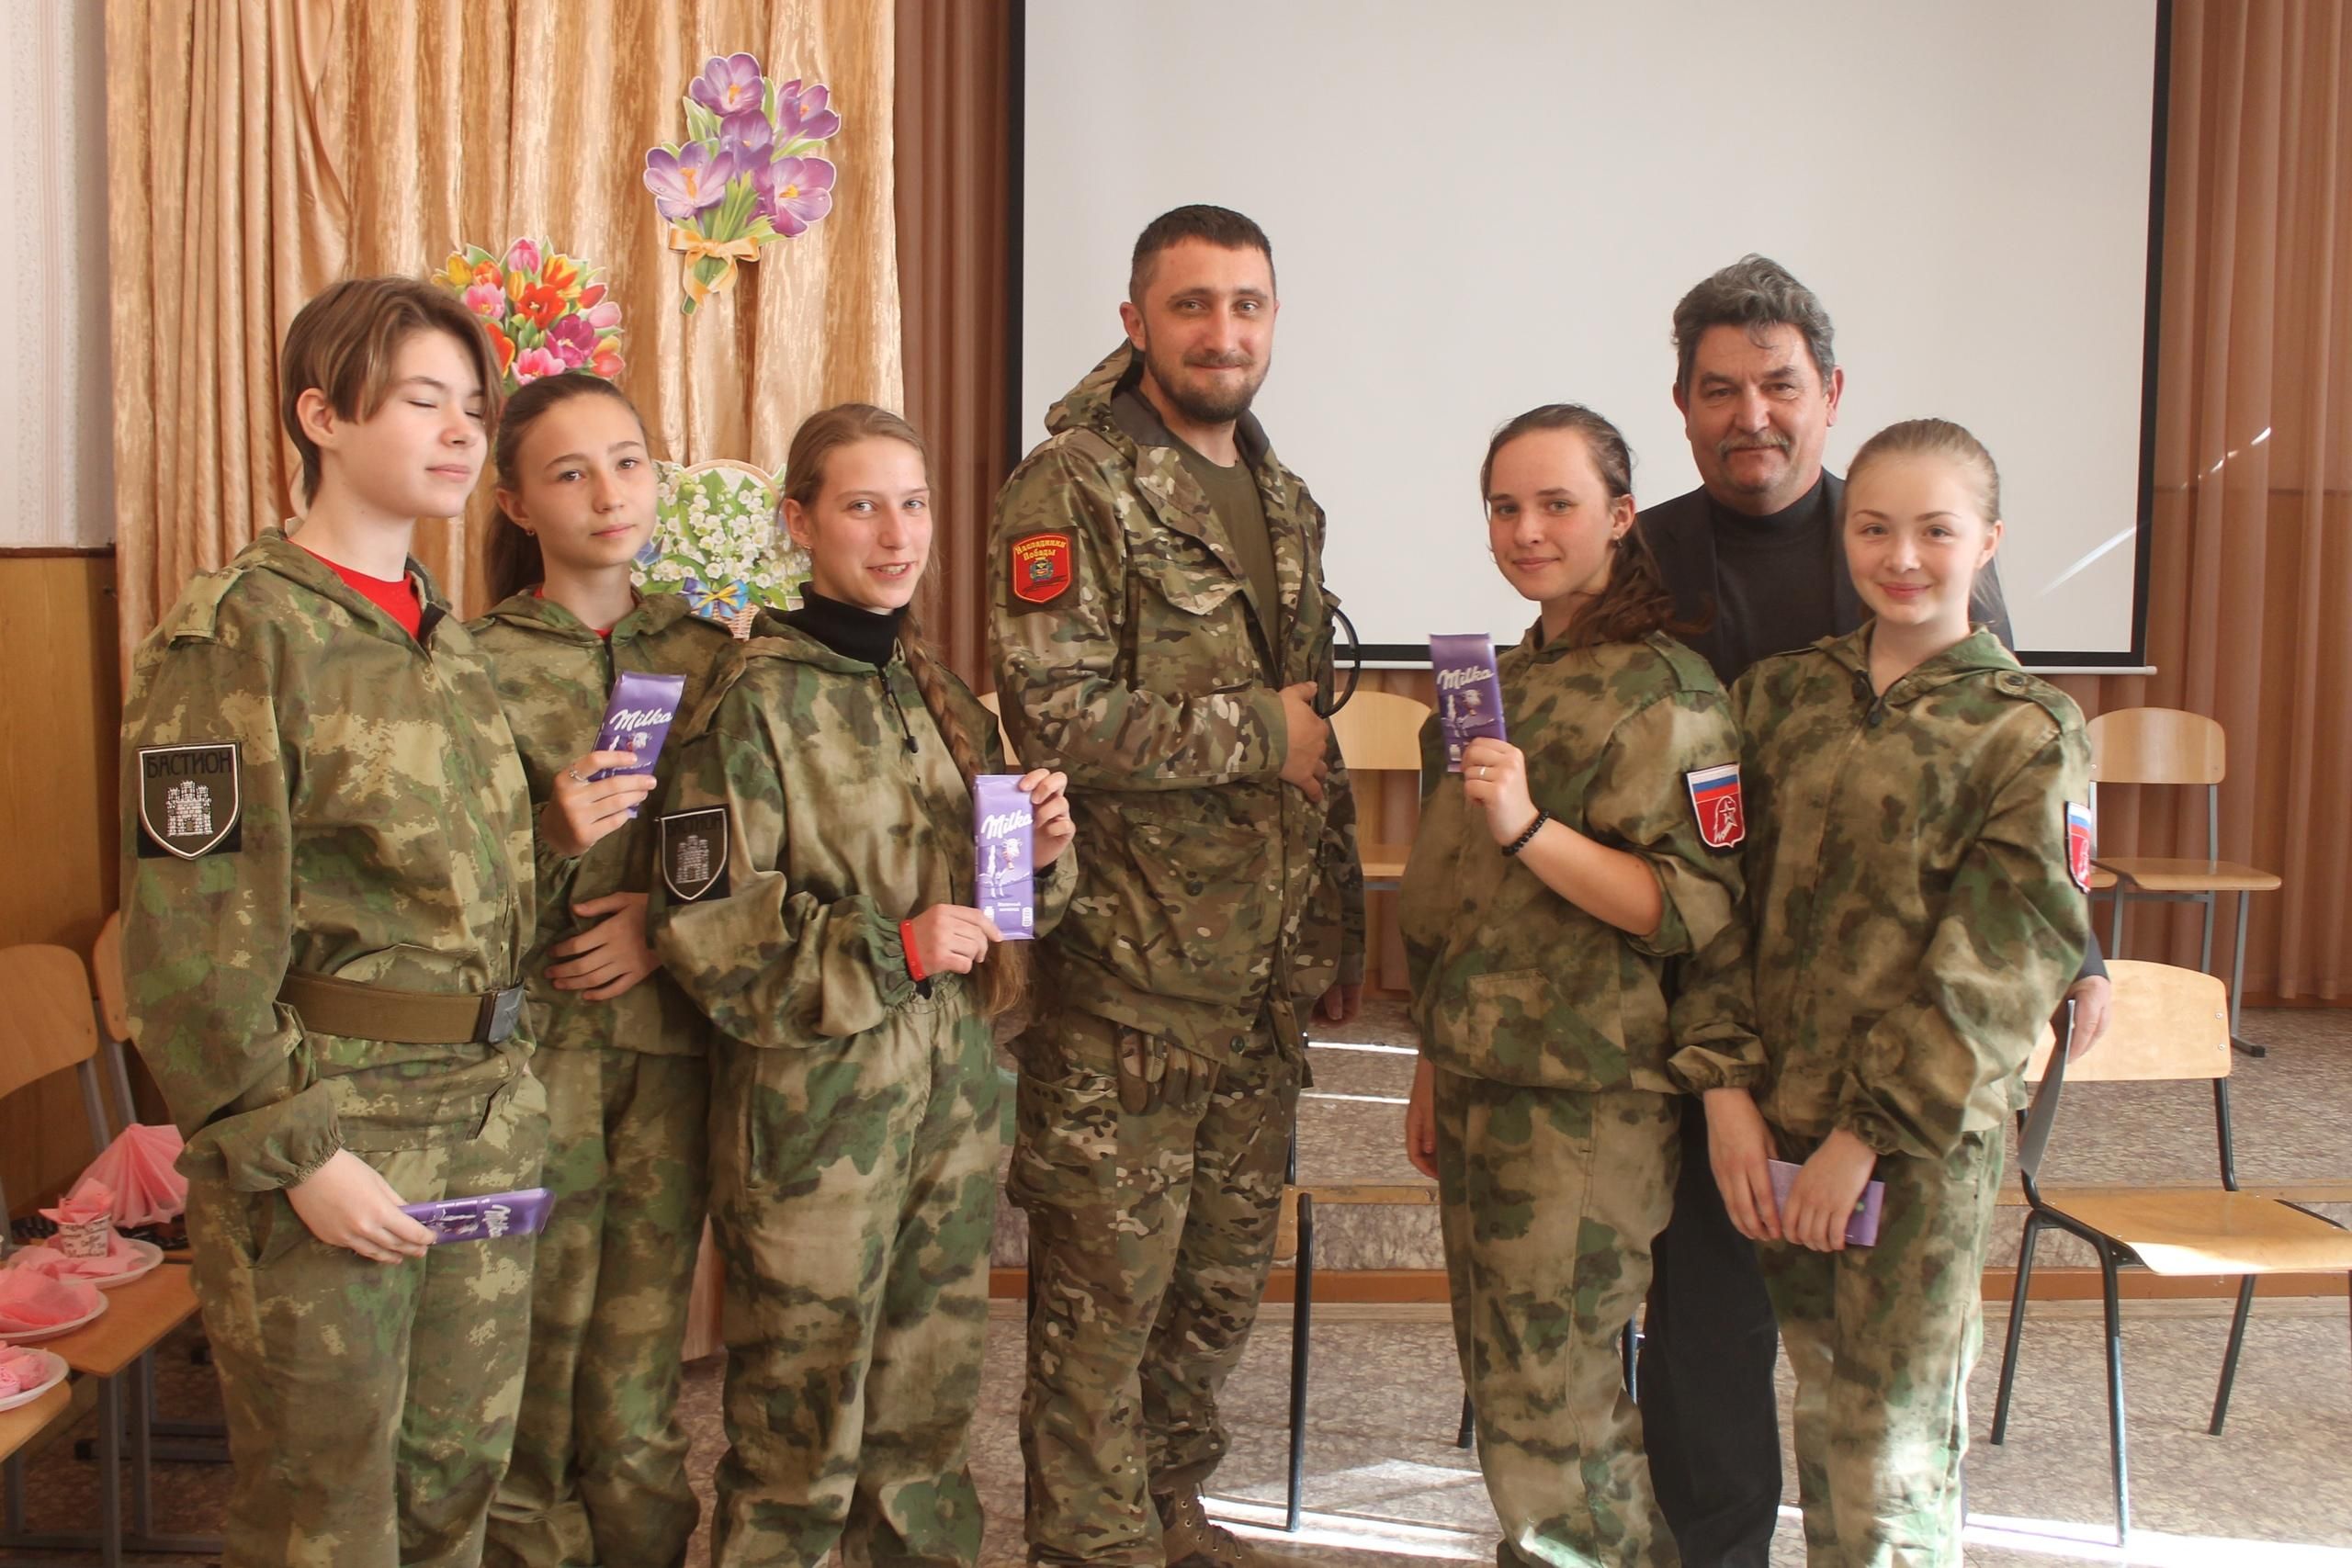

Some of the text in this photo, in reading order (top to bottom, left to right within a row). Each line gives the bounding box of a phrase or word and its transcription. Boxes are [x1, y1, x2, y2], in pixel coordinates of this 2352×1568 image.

[1023, 548, 1056, 560] Победы
[1436, 666, 1495, 690] Milka
[609, 708, 673, 731] Milka
[146, 751, 232, 778] БАСТИОН
[980, 809, 1034, 840] Milka
